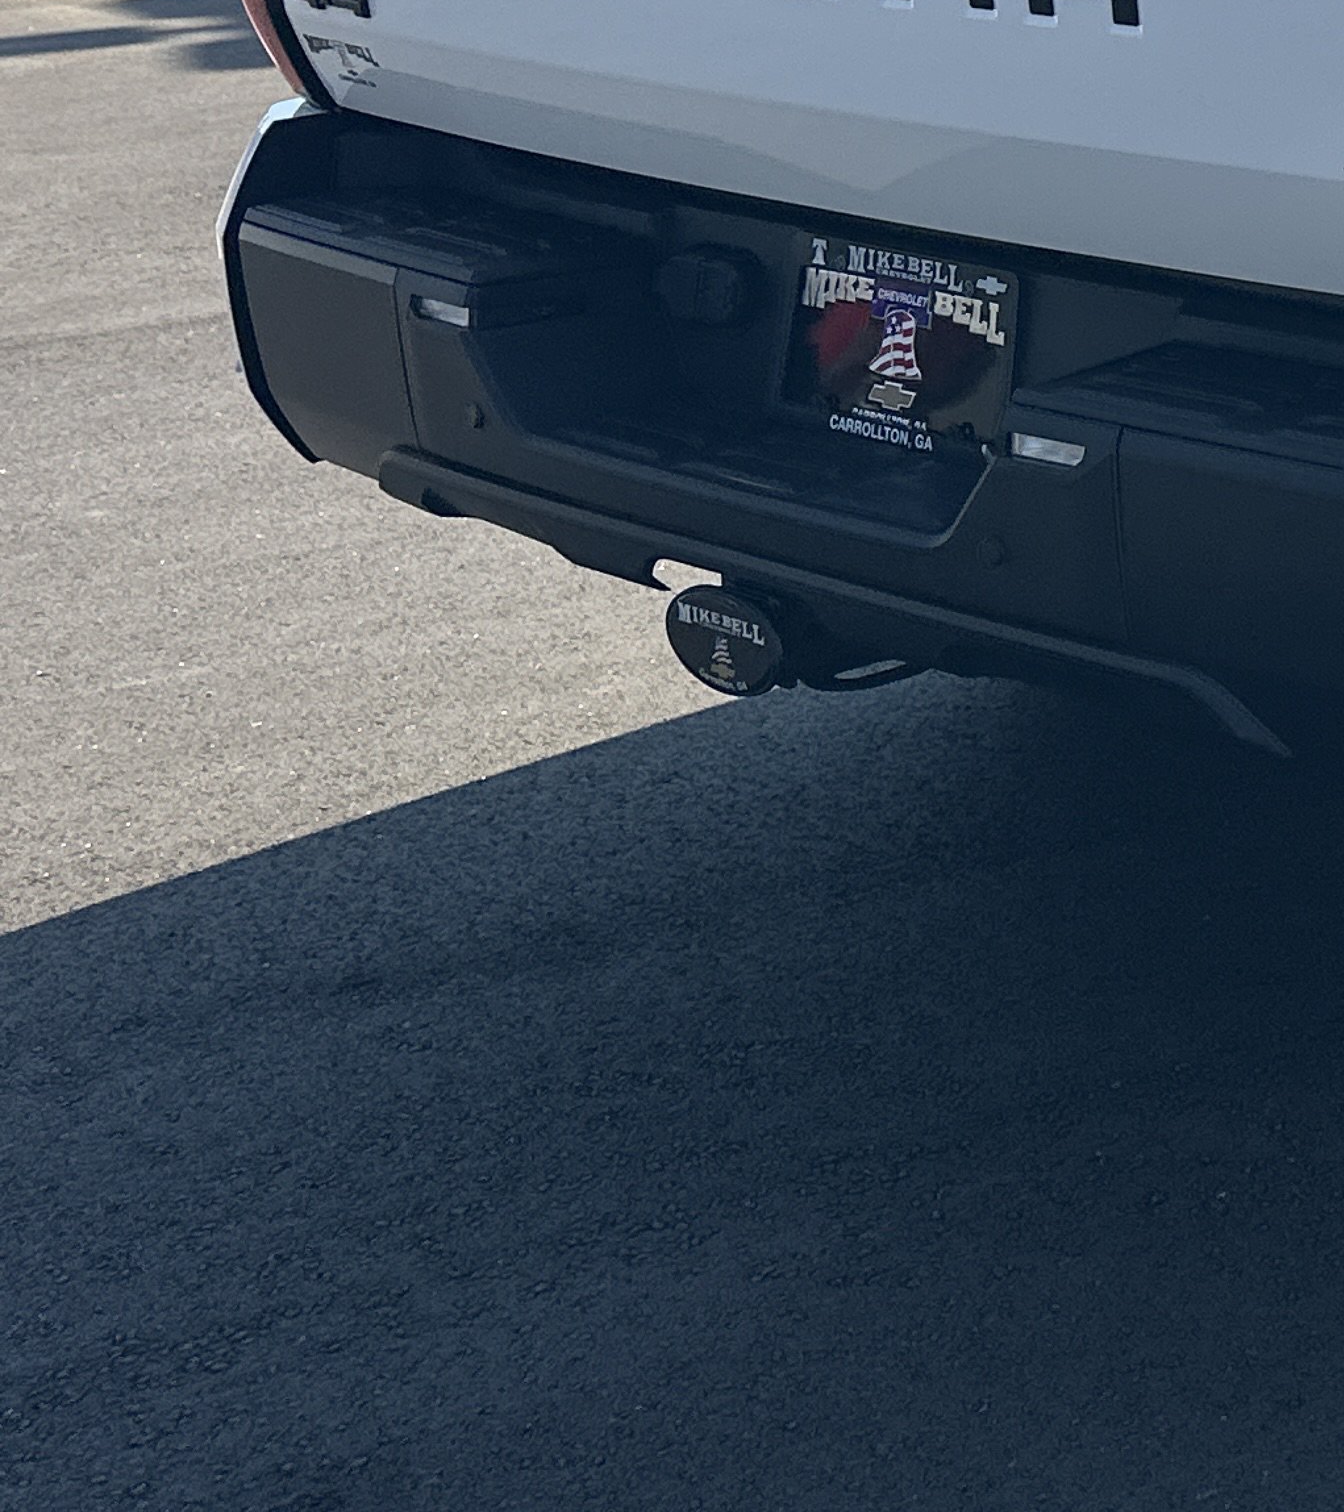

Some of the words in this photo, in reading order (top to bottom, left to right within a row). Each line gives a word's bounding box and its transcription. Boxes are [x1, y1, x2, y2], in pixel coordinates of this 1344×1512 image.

[847, 245, 905, 273] MIKE
[907, 258, 963, 291] BELL
[801, 267, 876, 309] MIKE
[933, 291, 1005, 346] BELL
[877, 288, 929, 308] CHEVROLET
[829, 413, 912, 449] CARROLLTON,
[914, 433, 933, 452] GA
[678, 601, 721, 625] MIKE
[721, 615, 765, 646] BELL
